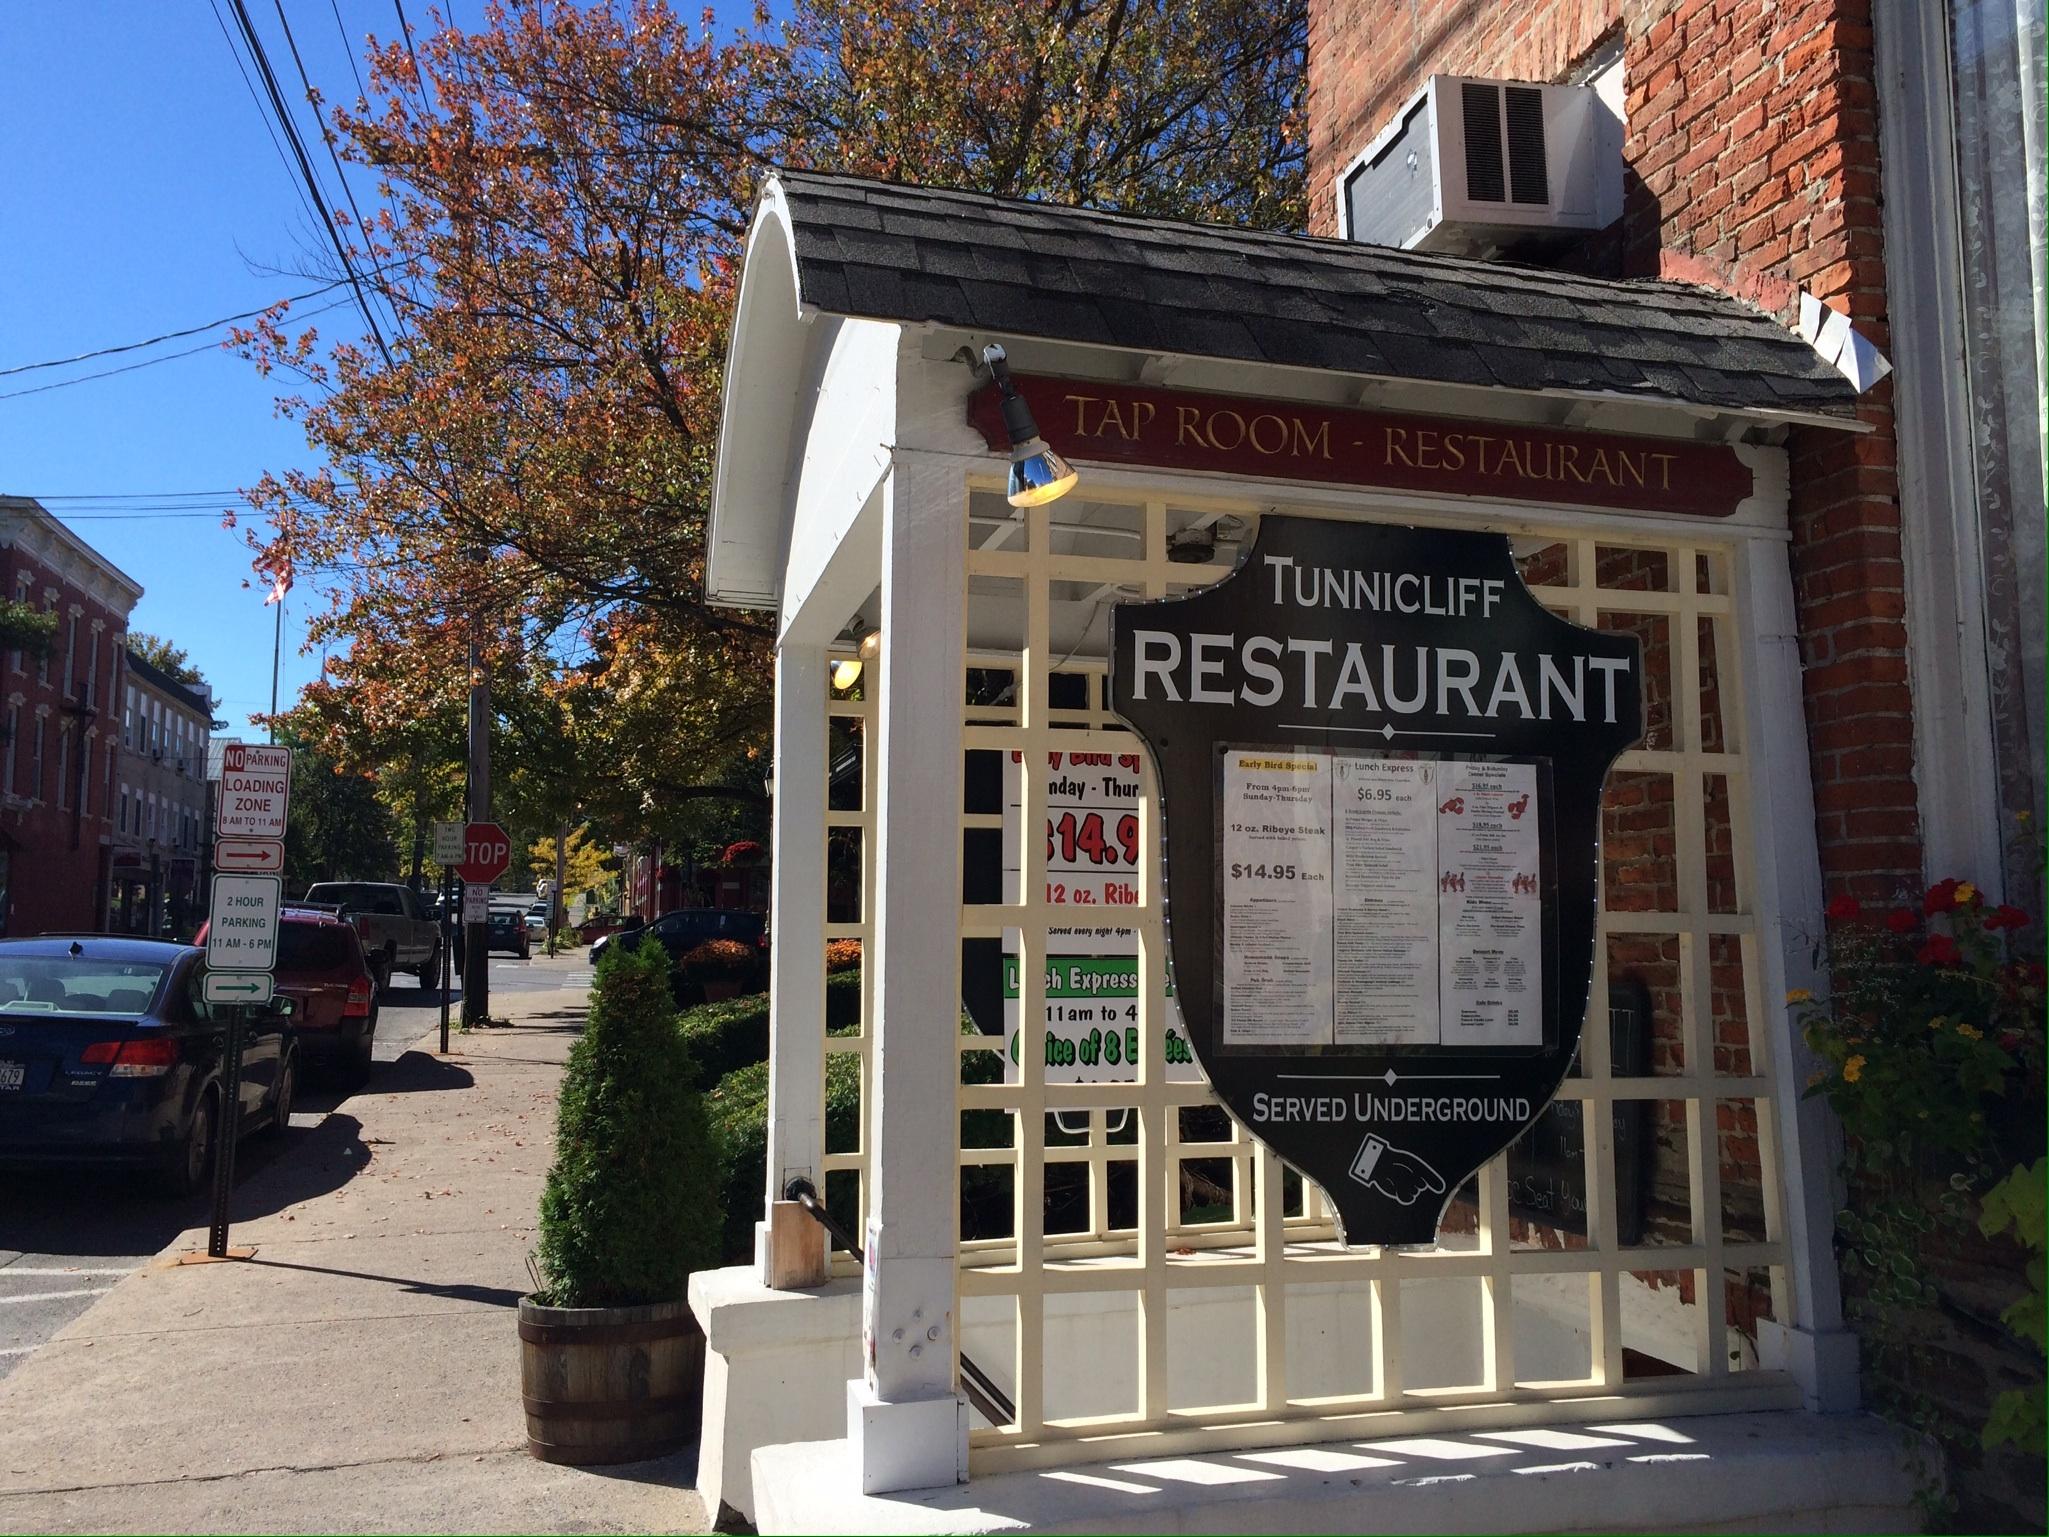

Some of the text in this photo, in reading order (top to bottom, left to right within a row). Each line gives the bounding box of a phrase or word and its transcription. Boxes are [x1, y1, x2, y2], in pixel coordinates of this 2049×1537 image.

[1064, 395, 1156, 441] TAP
[1175, 406, 1334, 459] ROOM
[1383, 427, 1680, 490] RESTAURANT
[1263, 553, 1505, 618] TUNNICLIFF
[1131, 629, 1630, 723] RESTAURANT
[225, 750, 287, 768] NO PARKING
[1239, 760, 1318, 771] Early Bird Special
[1355, 762, 1414, 774] Lunch Express
[225, 778, 284, 793] LOADING
[1049, 776, 1085, 800] nday
[1102, 777, 1139, 797] Thur
[1246, 783, 1269, 791] From
[1358, 787, 1392, 802] $6.95
[235, 798, 271, 812] ZONE
[223, 816, 281, 827] 8 AM TO 11 AM
[1231, 824, 1242, 832] 12
[1262, 825, 1295, 835] Ribeye
[1298, 826, 1326, 835] Steak
[1047, 812, 1138, 866] 14.9
[1231, 862, 1324, 881] $14.95 Each
[1073, 888, 1096, 904] oz.
[1105, 883, 1138, 905] Rib
[227, 897, 264, 907] 2 HOUR
[222, 917, 266, 928] PARKING
[1048, 927, 1071, 935] Served
[1074, 928, 1092, 937] every
[1095, 928, 1112, 937] night
[1115, 927, 1131, 938] 4pm
[213, 938, 222, 948] 11
[225, 939, 240, 948] AM
[249, 939, 255, 949] 6
[257, 940, 271, 949] PM
[1009, 965, 1062, 990] Lch
[1070, 967, 1138, 995] Express
[1101, 1006, 1117, 1021] to
[1079, 1028, 1101, 1066] of
[1104, 1030, 1121, 1065] 8
[0, 1069, 20, 1083] 679
[1252, 1092, 1347, 1122] SERVED
[1354, 1093, 1530, 1122] UNDERGROUND
